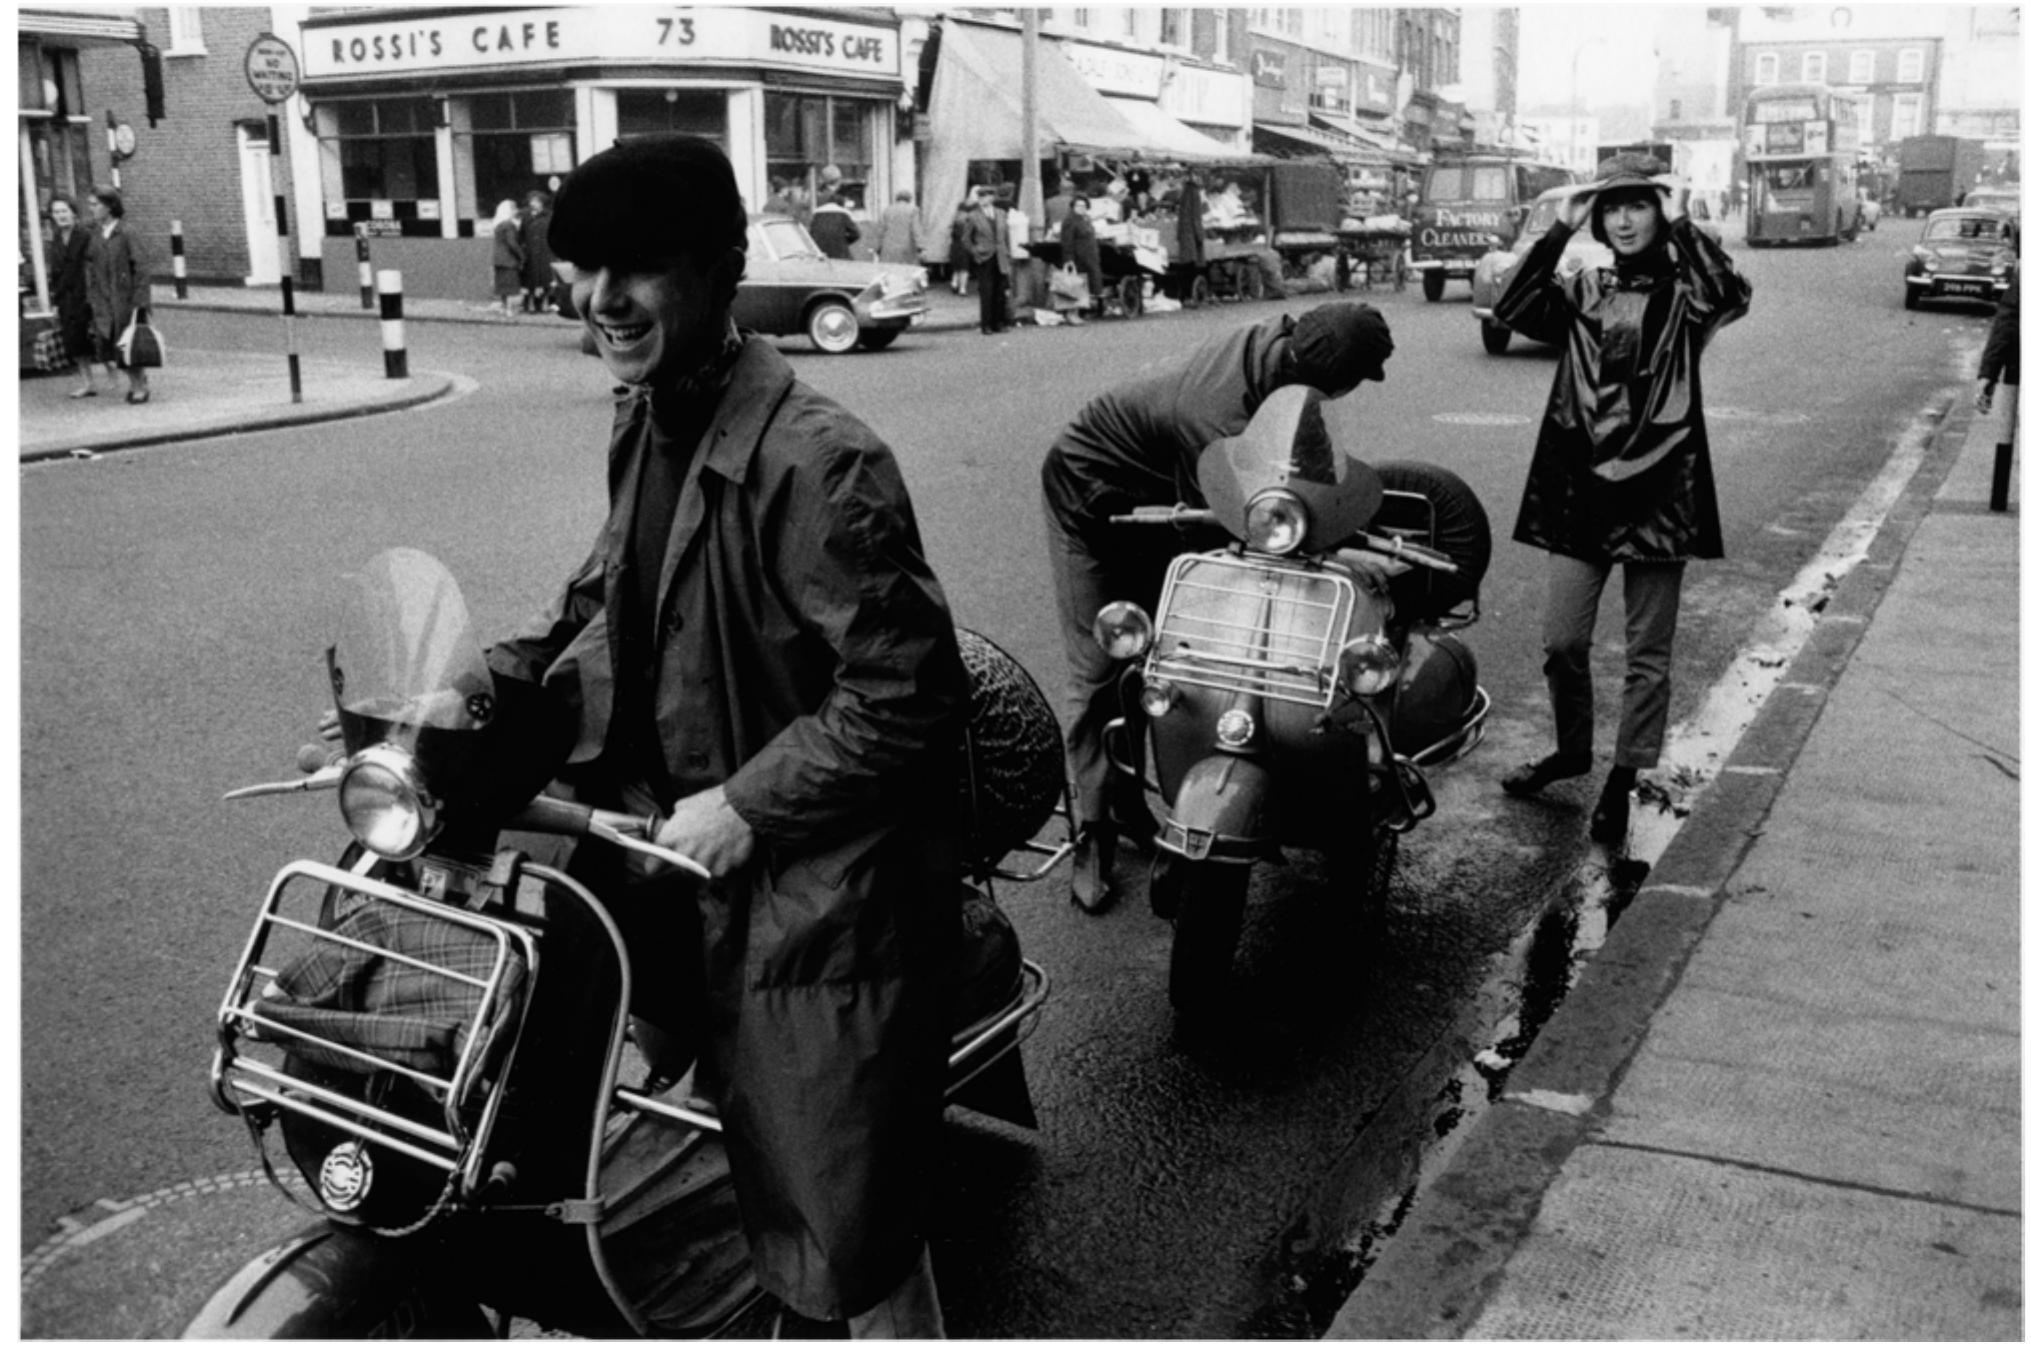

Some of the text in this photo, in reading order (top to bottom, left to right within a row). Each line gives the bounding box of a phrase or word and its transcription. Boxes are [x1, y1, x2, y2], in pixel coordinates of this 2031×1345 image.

[332, 21, 560, 63] ROSSI'S CAFE
[656, 18, 696, 45] 73
[770, 24, 883, 63] ROSSI'S CAFE
